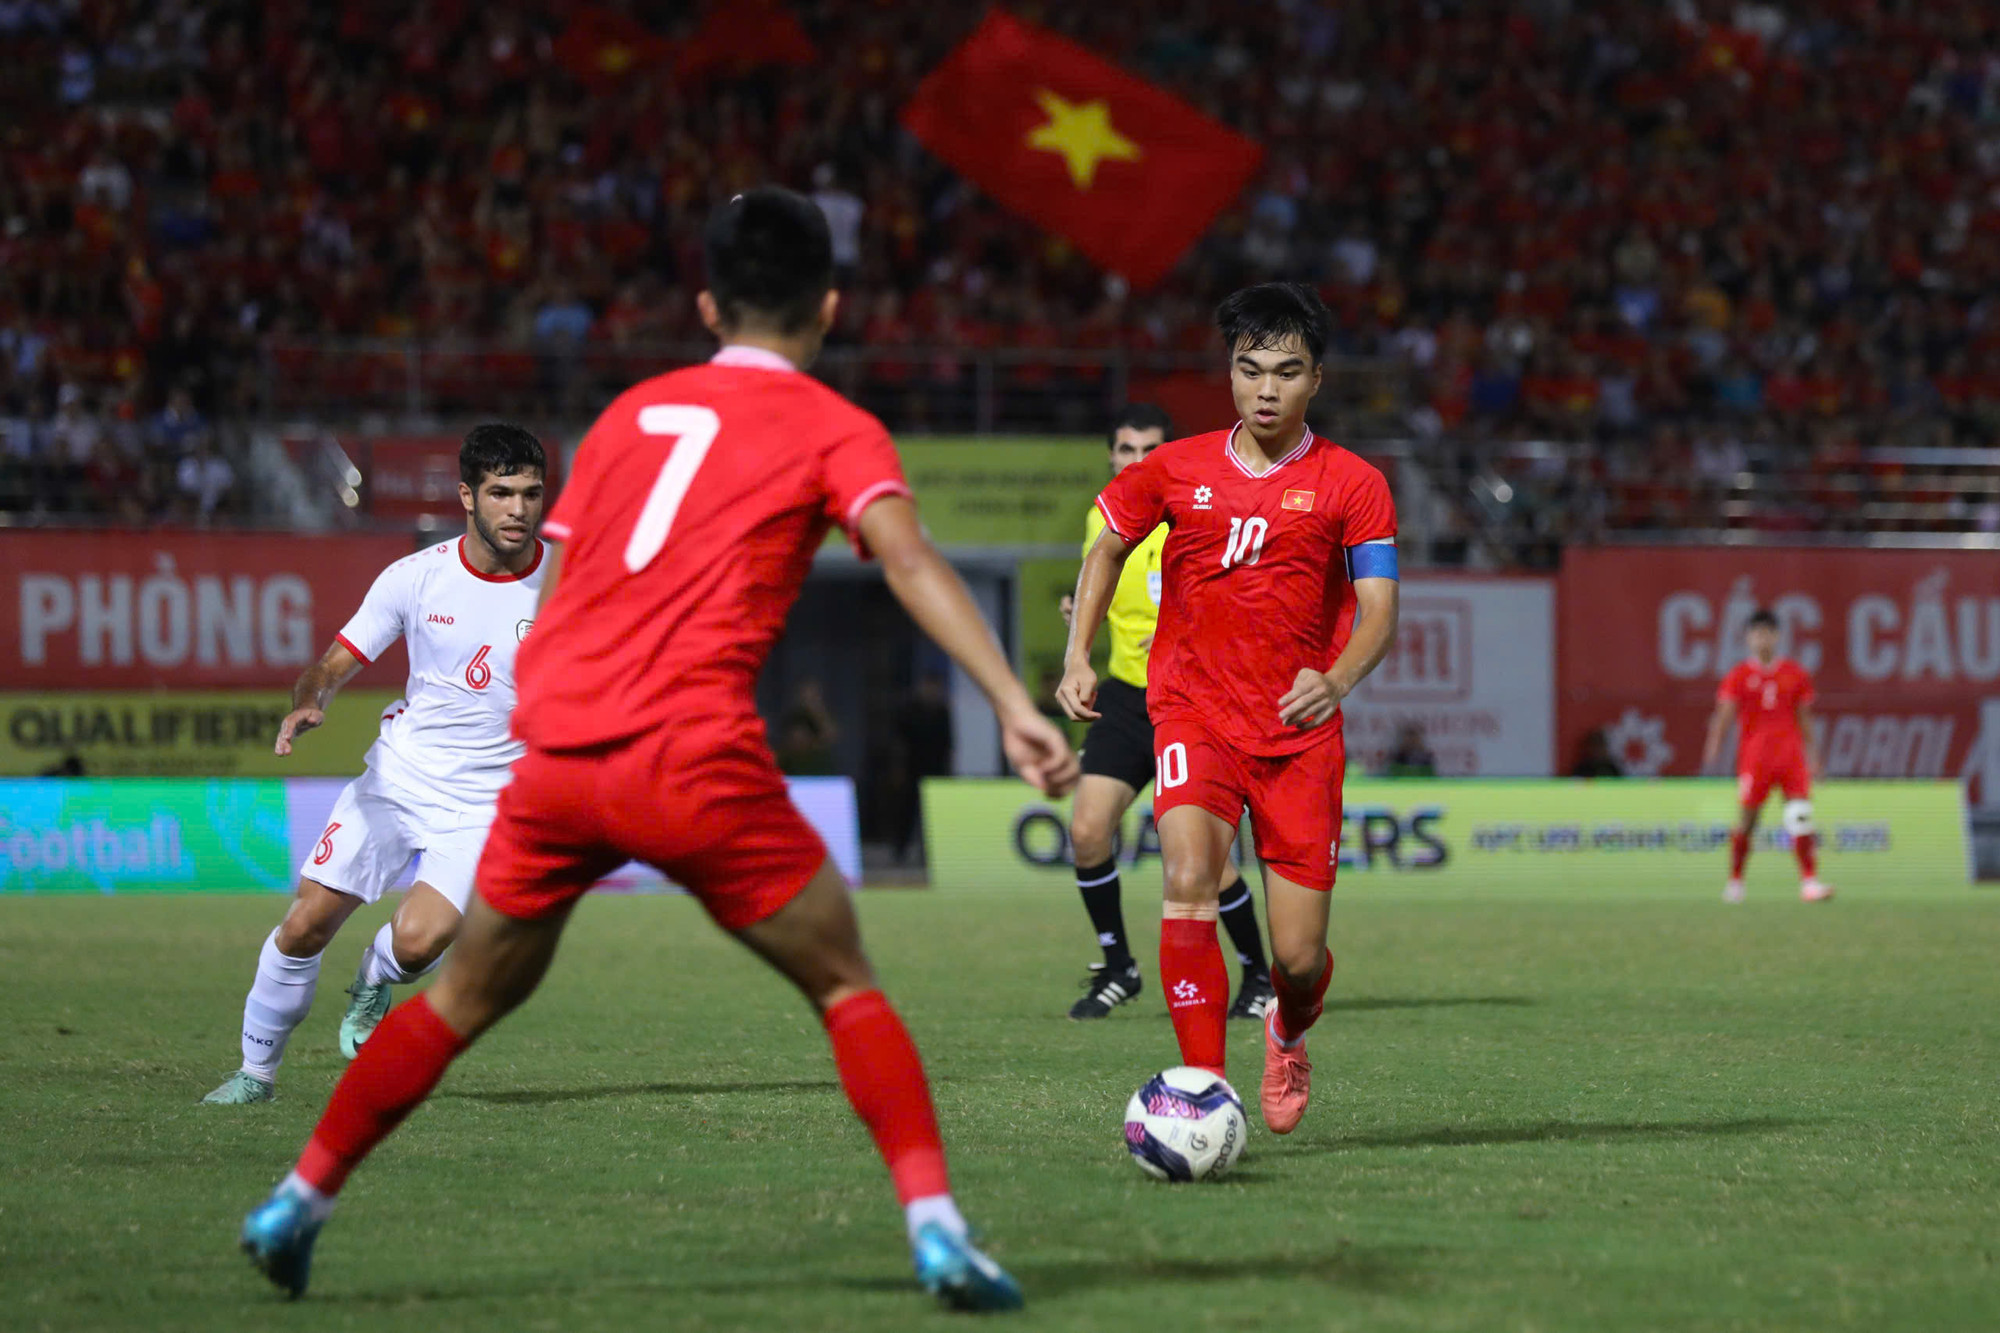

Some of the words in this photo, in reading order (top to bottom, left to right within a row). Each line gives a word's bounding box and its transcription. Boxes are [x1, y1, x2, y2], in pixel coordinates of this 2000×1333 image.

[623, 403, 722, 574] 7
[1221, 516, 1269, 569] 10
[20, 552, 312, 668] PHÒNG
[427, 613, 455, 626] JAKO
[465, 644, 492, 690] 6
[313, 821, 343, 866] 6
[244, 1031, 274, 1047] JAKO
